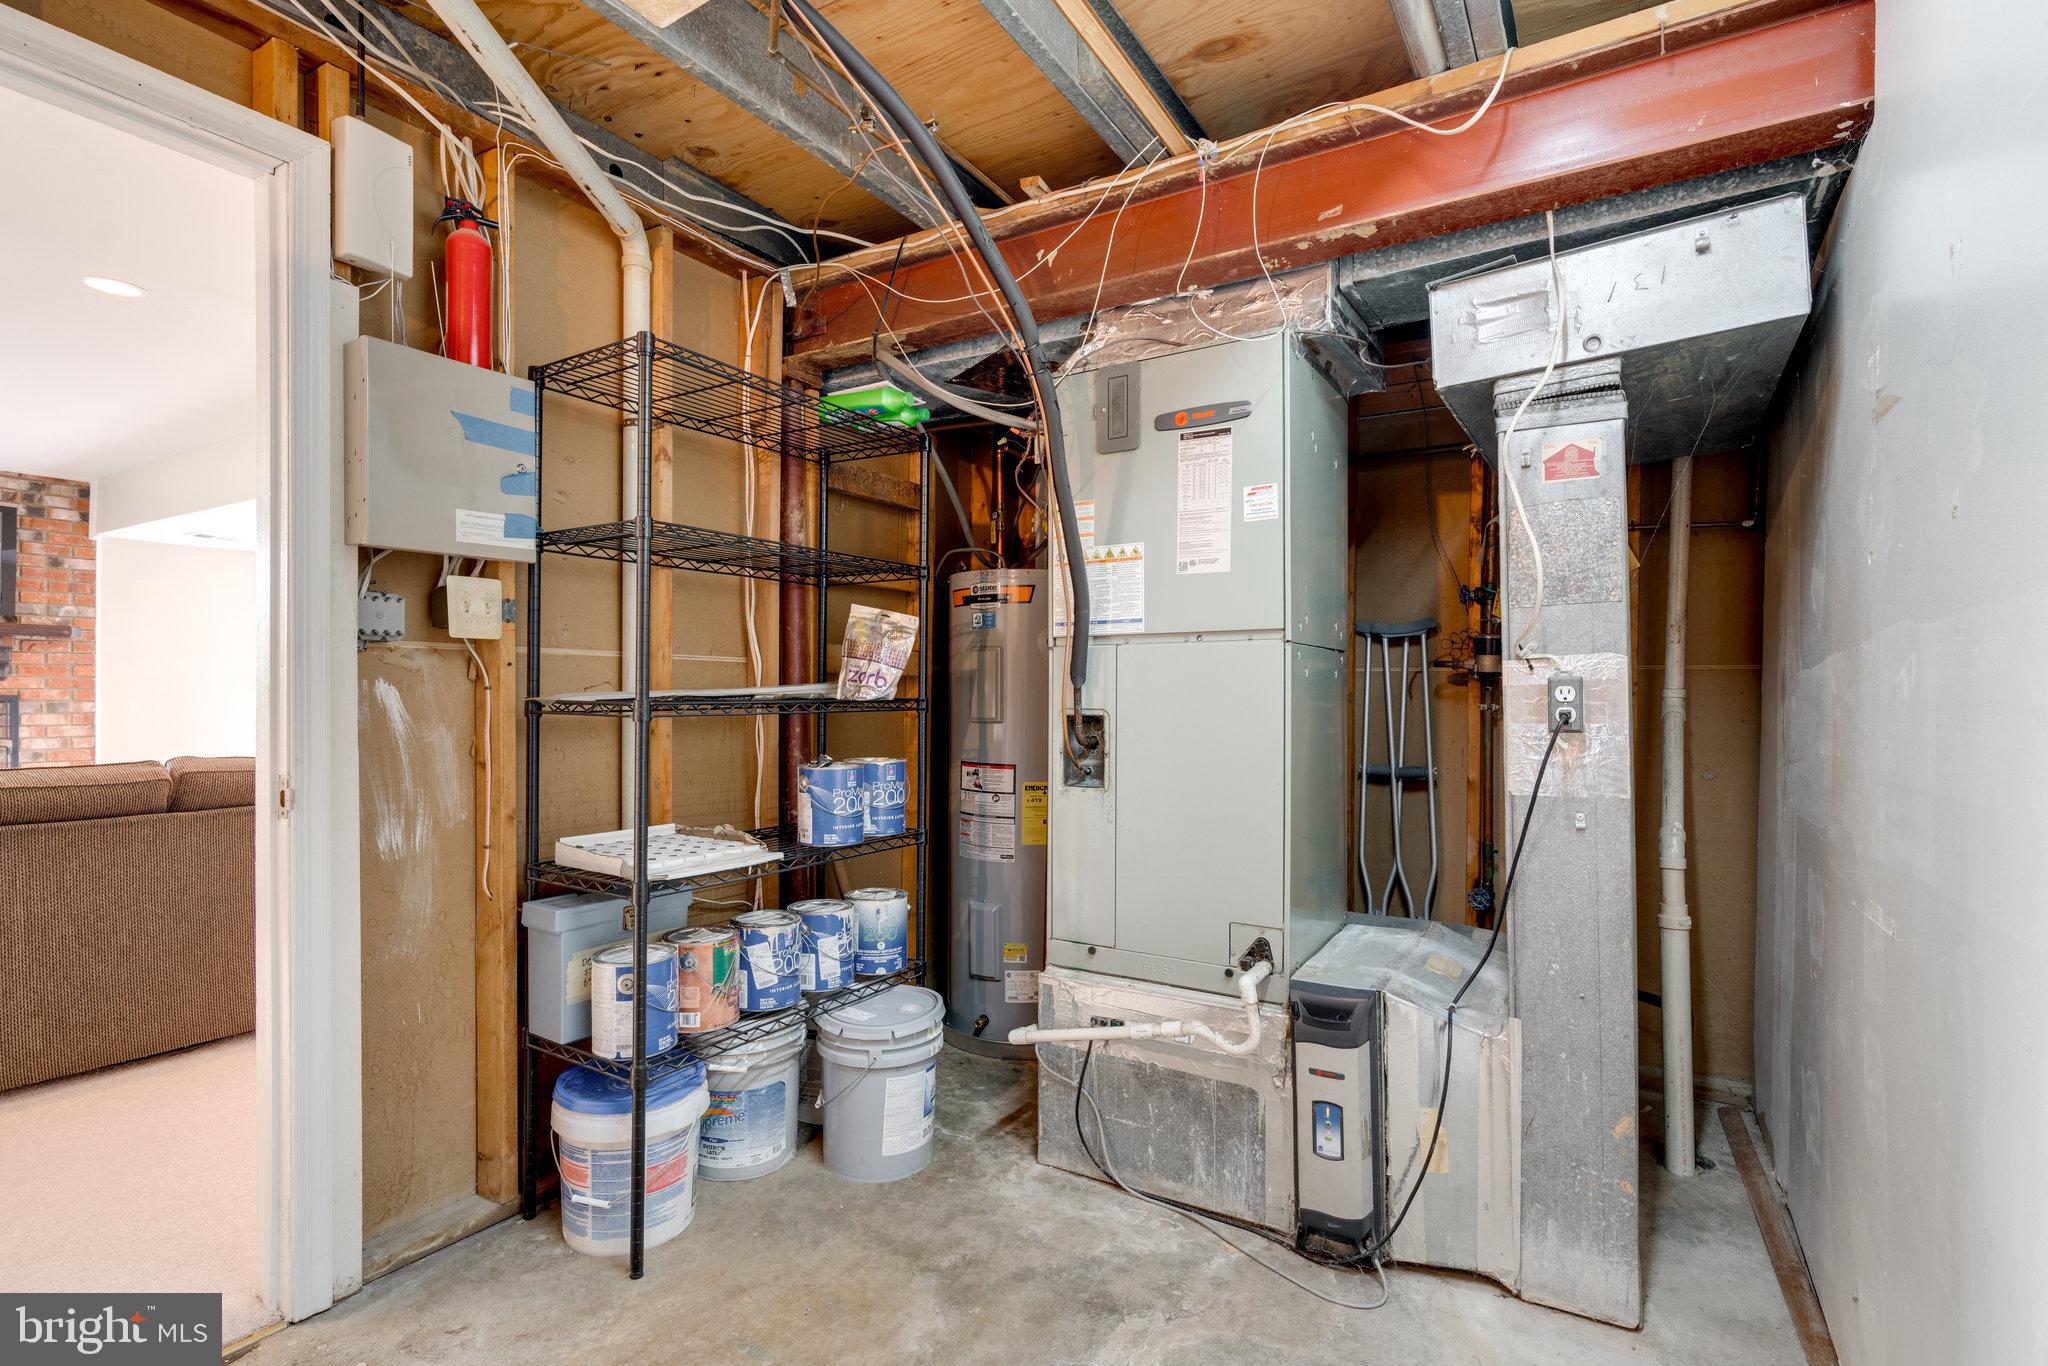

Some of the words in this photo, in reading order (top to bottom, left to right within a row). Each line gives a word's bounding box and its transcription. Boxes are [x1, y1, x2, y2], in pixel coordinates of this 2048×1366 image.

[847, 668, 888, 689] zorb
[873, 789, 905, 806] 200
[832, 823, 855, 831] INTERIOR
[863, 925, 898, 942] 200
